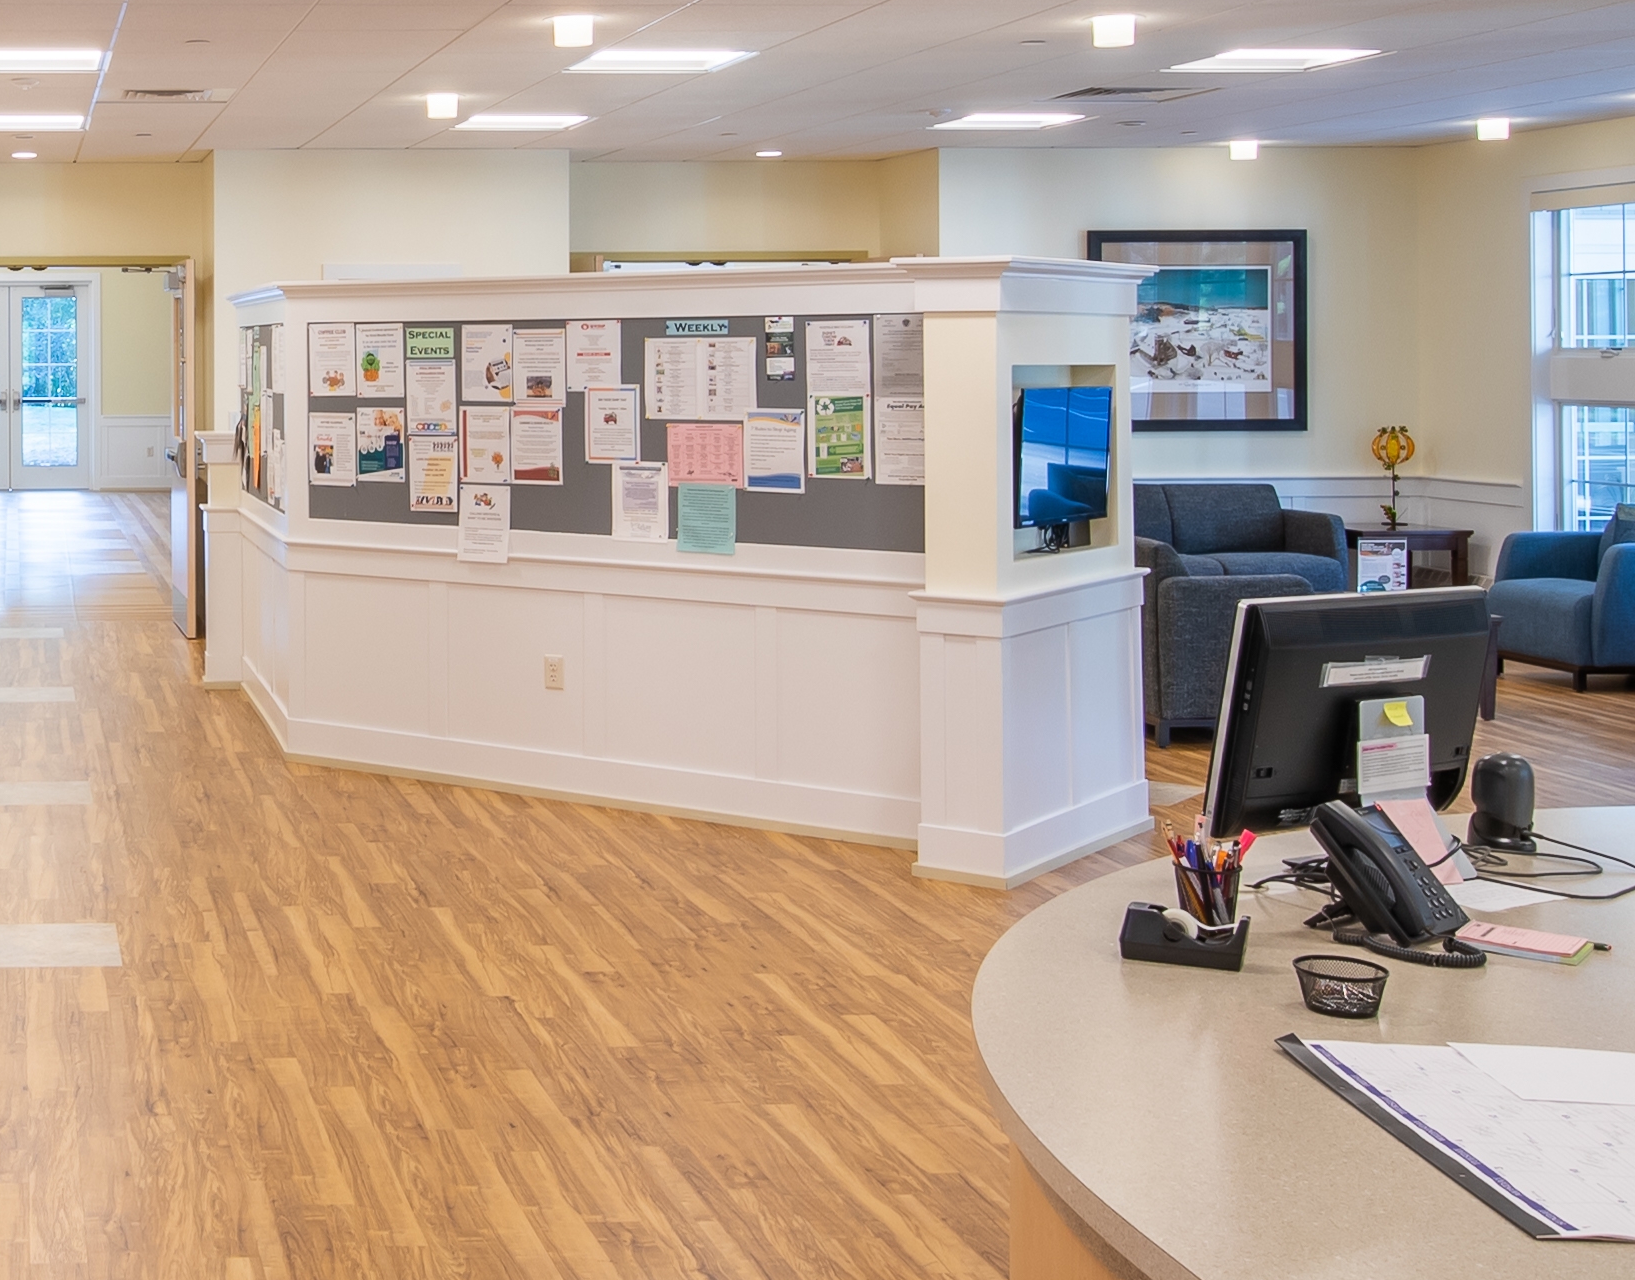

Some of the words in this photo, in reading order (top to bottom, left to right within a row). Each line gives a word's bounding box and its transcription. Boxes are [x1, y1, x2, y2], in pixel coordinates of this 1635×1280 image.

[674, 322, 724, 333] WEEKLY
[408, 330, 451, 339] SPECIAL
[410, 346, 450, 355] EVENTS
